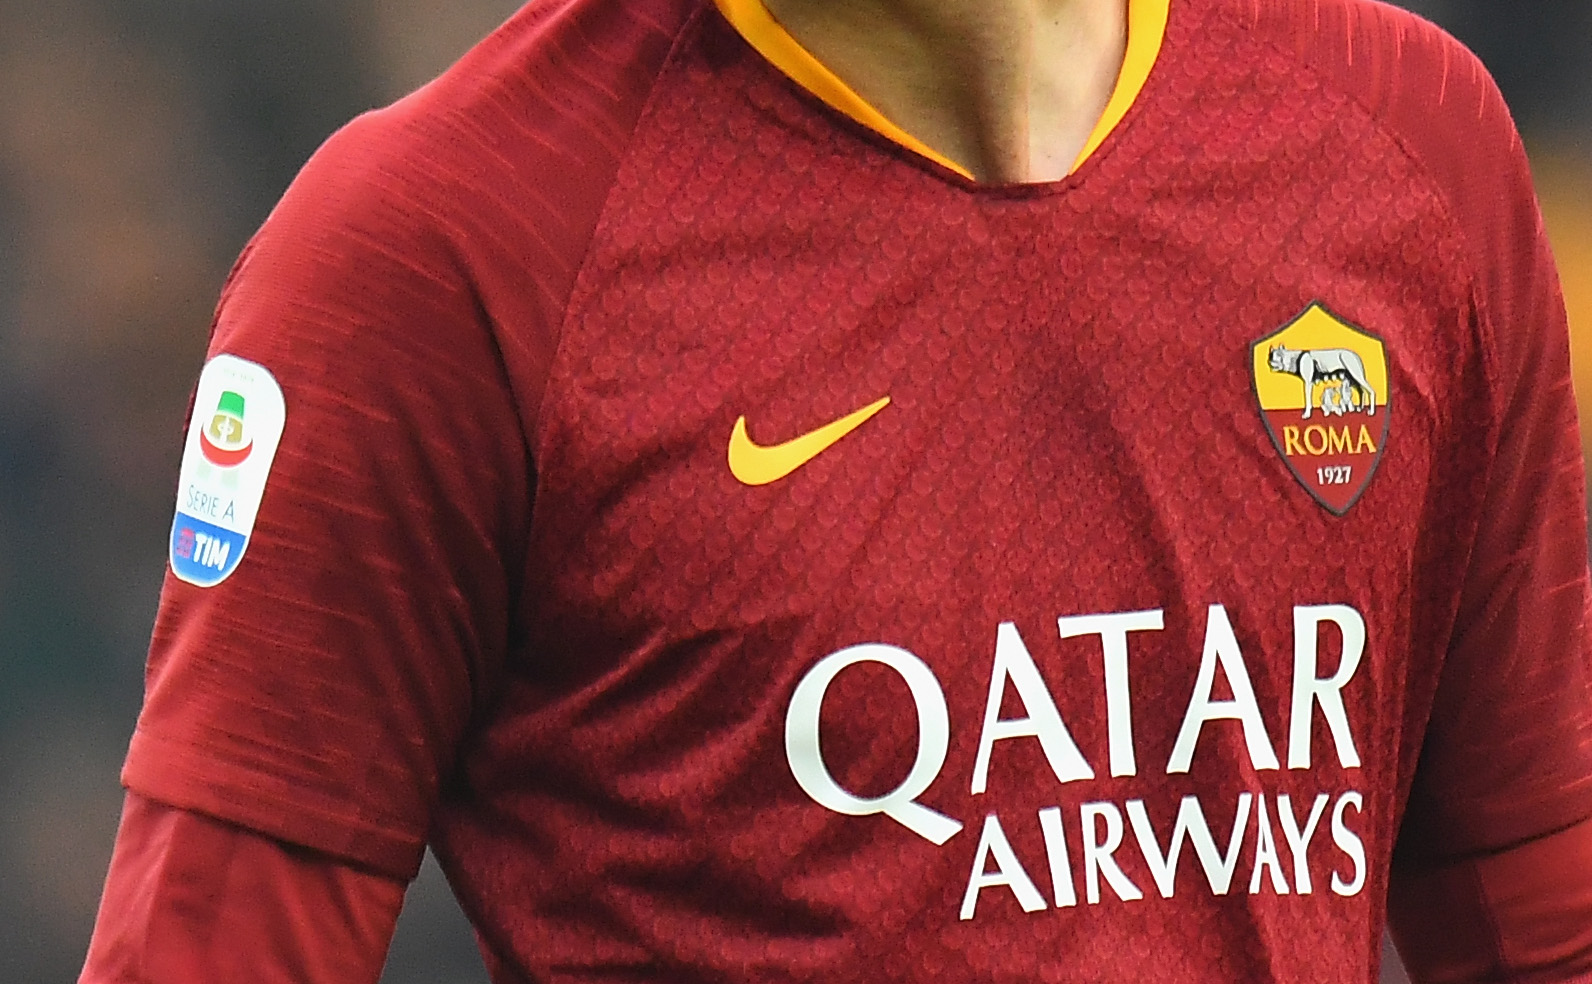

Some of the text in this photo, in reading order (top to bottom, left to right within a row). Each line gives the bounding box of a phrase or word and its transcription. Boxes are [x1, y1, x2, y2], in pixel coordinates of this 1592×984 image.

[1283, 424, 1377, 456] ROMA
[1317, 466, 1352, 485] 1927
[186, 484, 234, 524] SERIE A
[193, 533, 231, 571] TIM
[785, 604, 1366, 846] QATAR
[959, 791, 1366, 921] AIRWAYS
